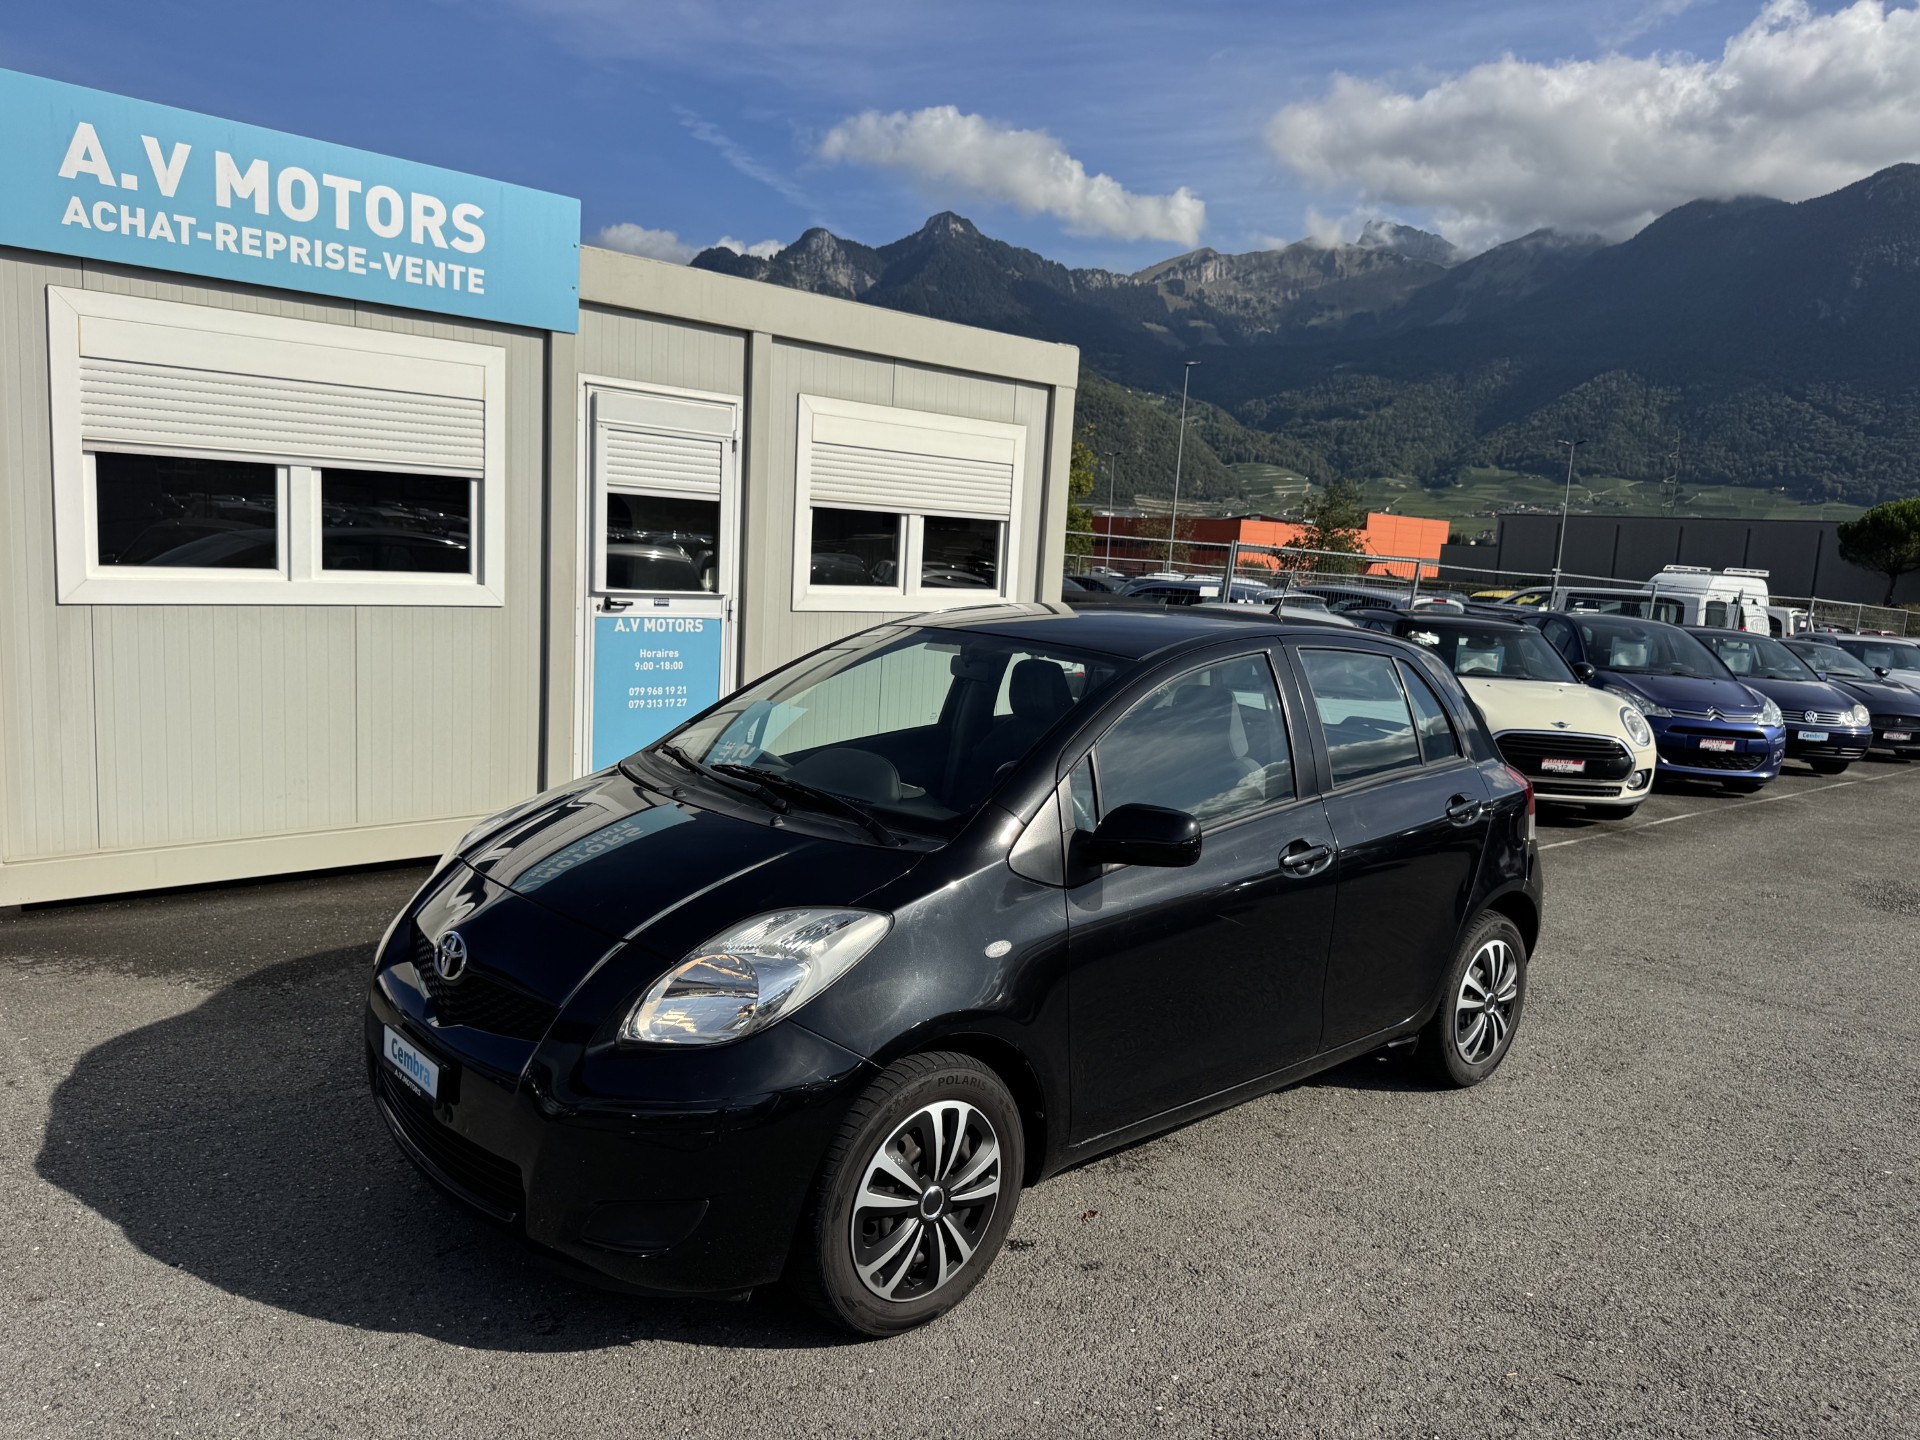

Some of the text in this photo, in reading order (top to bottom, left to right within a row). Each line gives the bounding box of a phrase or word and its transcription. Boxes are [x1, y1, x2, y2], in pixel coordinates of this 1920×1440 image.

[58, 121, 486, 254] A.V MOTORS
[61, 196, 486, 295] ACHAT-REPRISE-VENTE
[614, 618, 704, 632] A.V MOTORS
[639, 649, 679, 658] Horaires
[634, 661, 654, 671] 9:00
[628, 686, 687, 696] 079 968 19 21
[628, 698, 688, 709] 079 313 17 27
[391, 1037, 431, 1088] Cembra
[937, 1075, 986, 1091] POLARIS
